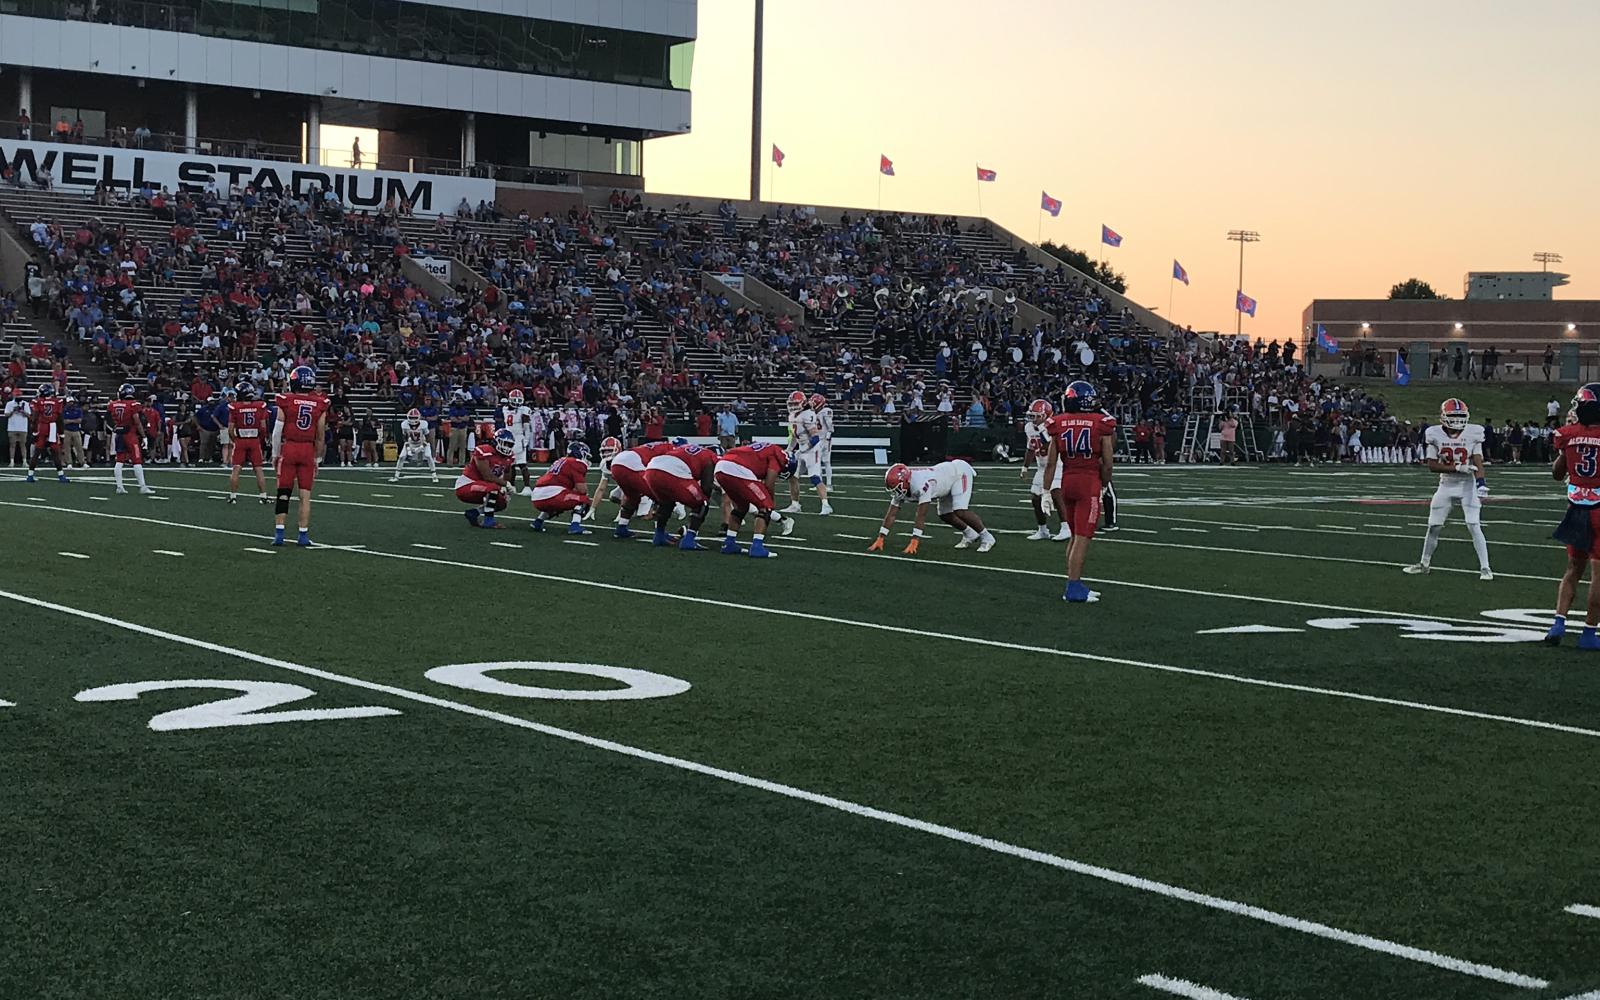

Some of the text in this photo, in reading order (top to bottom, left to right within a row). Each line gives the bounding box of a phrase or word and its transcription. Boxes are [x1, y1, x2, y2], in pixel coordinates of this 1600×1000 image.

[177, 161, 433, 211] STADIUM
[297, 405, 312, 430] 5
[1061, 427, 1093, 459] 14
[1575, 445, 1598, 478] 3
[75, 660, 692, 731] 20
